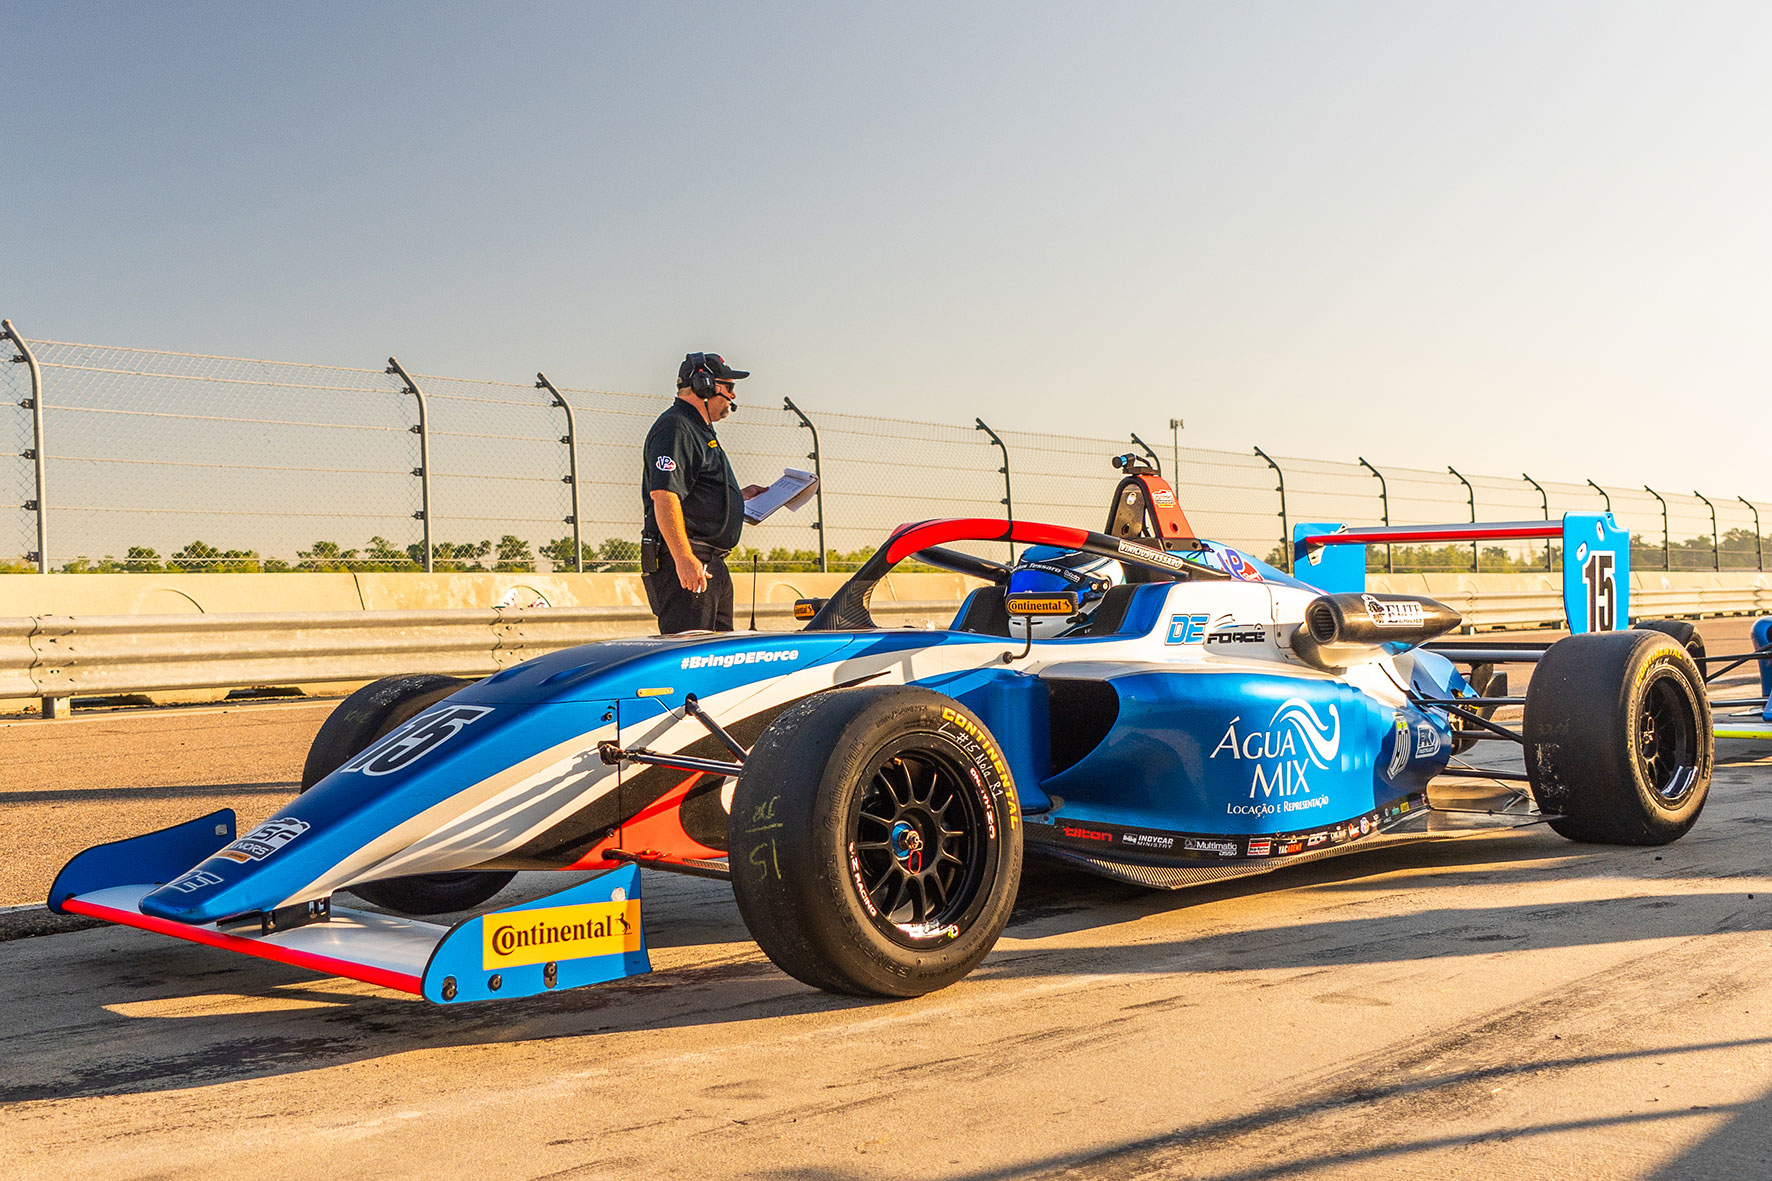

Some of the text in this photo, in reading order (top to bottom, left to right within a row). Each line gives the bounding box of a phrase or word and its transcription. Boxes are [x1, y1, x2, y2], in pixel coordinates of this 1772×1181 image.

[1120, 541, 1181, 568] VINICIUS TESSARO
[1008, 600, 1062, 613] Continental
[1583, 553, 1615, 632] 15
[1166, 614, 1266, 645] DE FORCE
[681, 650, 799, 669] #BringDEForce
[1635, 647, 1682, 688] CONTINENTAL
[340, 705, 496, 777] 15
[956, 731, 981, 753] #15
[1209, 716, 1297, 759] ÁGUA
[942, 706, 1019, 831] CONTINENTAL
[1249, 757, 1311, 798] MIX
[1063, 826, 1113, 842] tilton
[1136, 841, 1173, 849] MINISTRY
[1138, 834, 1174, 845] INDYCAR
[1196, 840, 1238, 850] Multimatic
[854, 872, 878, 917] RACING
[491, 914, 612, 957] Continental
